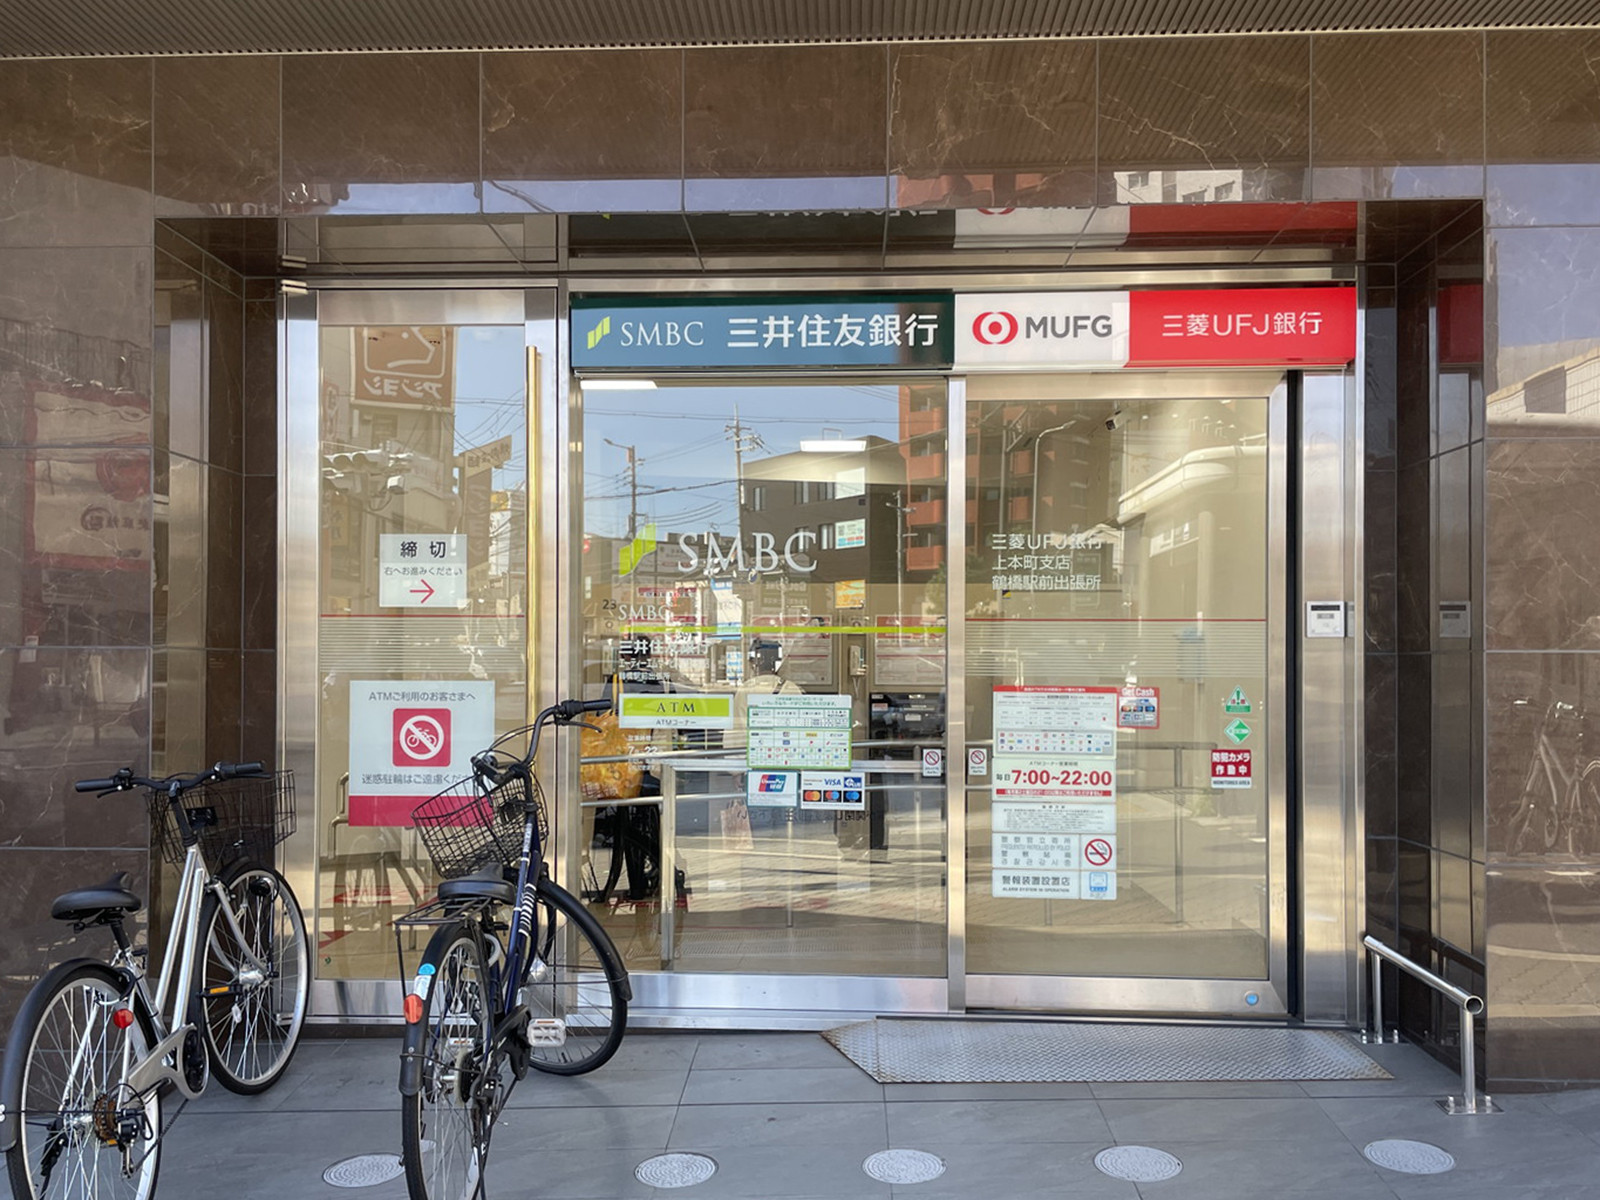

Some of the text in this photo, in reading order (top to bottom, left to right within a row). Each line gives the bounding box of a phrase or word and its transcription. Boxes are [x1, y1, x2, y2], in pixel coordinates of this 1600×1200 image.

[727, 314, 938, 348] 三井住友銀行
[1027, 315, 1113, 338] MUFG
[1162, 311, 1323, 338] 三菱UFJ銀行
[620, 321, 705, 347] SMBC
[400, 540, 447, 558] 締切
[677, 531, 818, 573] SMBC
[991, 554, 1071, 571] 上本町支店
[384, 566, 463, 577] 右へお進みください
[991, 574, 1102, 591] 鶴橋駅前出張所
[368, 691, 477, 702] ATMご利用のお客さまへ
[656, 702, 696, 713] ATM
[824, 778, 842, 786] VISA
